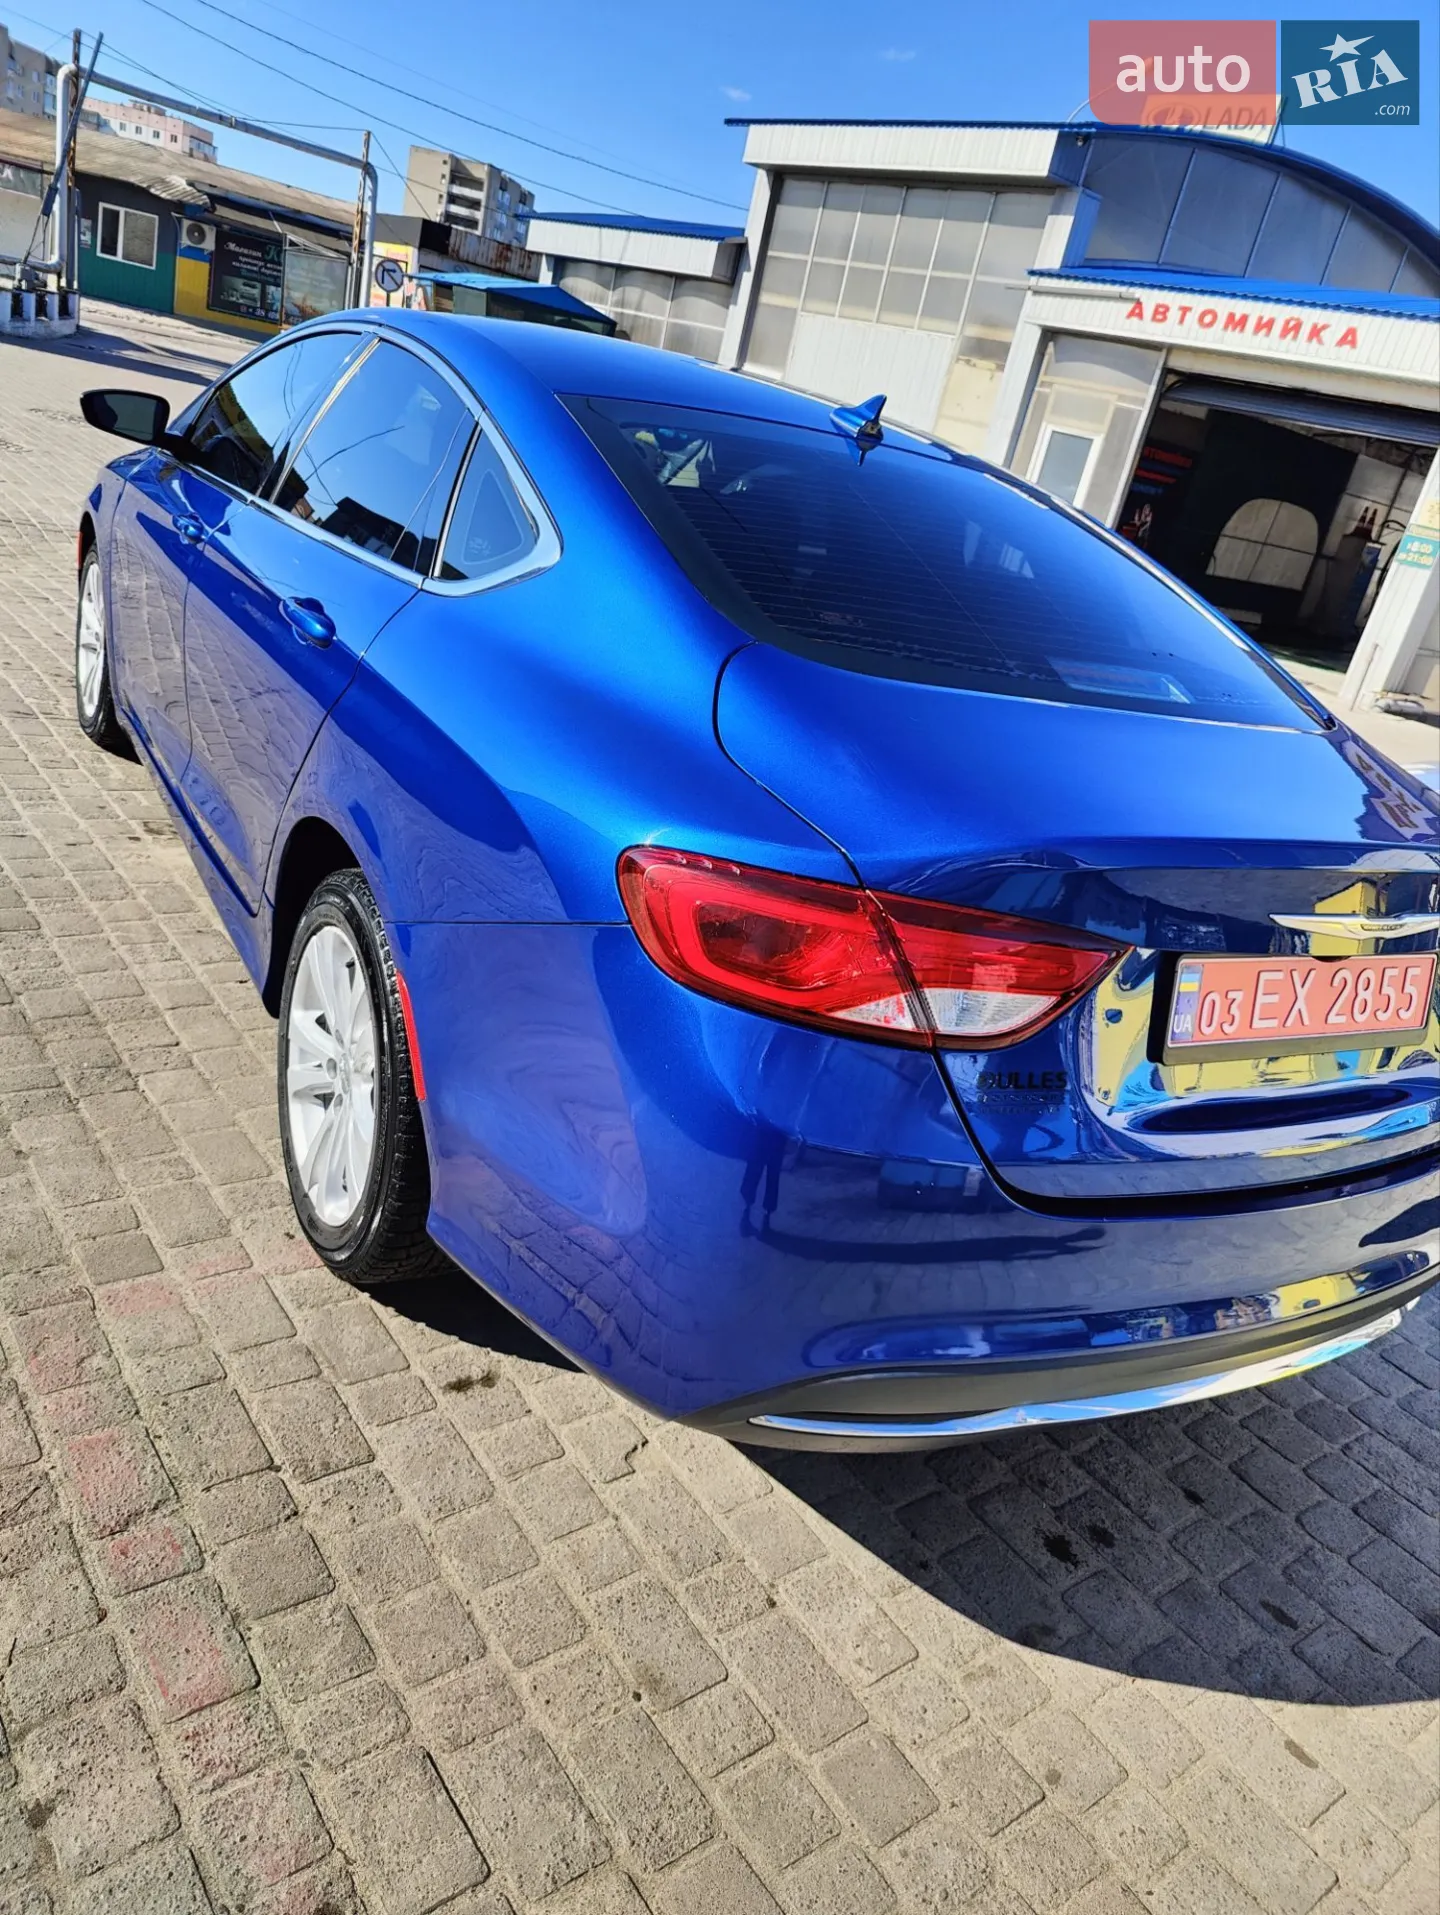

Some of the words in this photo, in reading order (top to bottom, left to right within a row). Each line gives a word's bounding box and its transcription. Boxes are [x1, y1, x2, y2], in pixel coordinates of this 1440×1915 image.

[1203, 105, 1268, 131] LADA
[1125, 300, 1360, 350] АВТОМИЙКА
[1199, 989, 1243, 1036] 03
[1250, 967, 1316, 1029] EX
[1325, 965, 1421, 1025] 2855
[1174, 1015, 1192, 1033] UA
